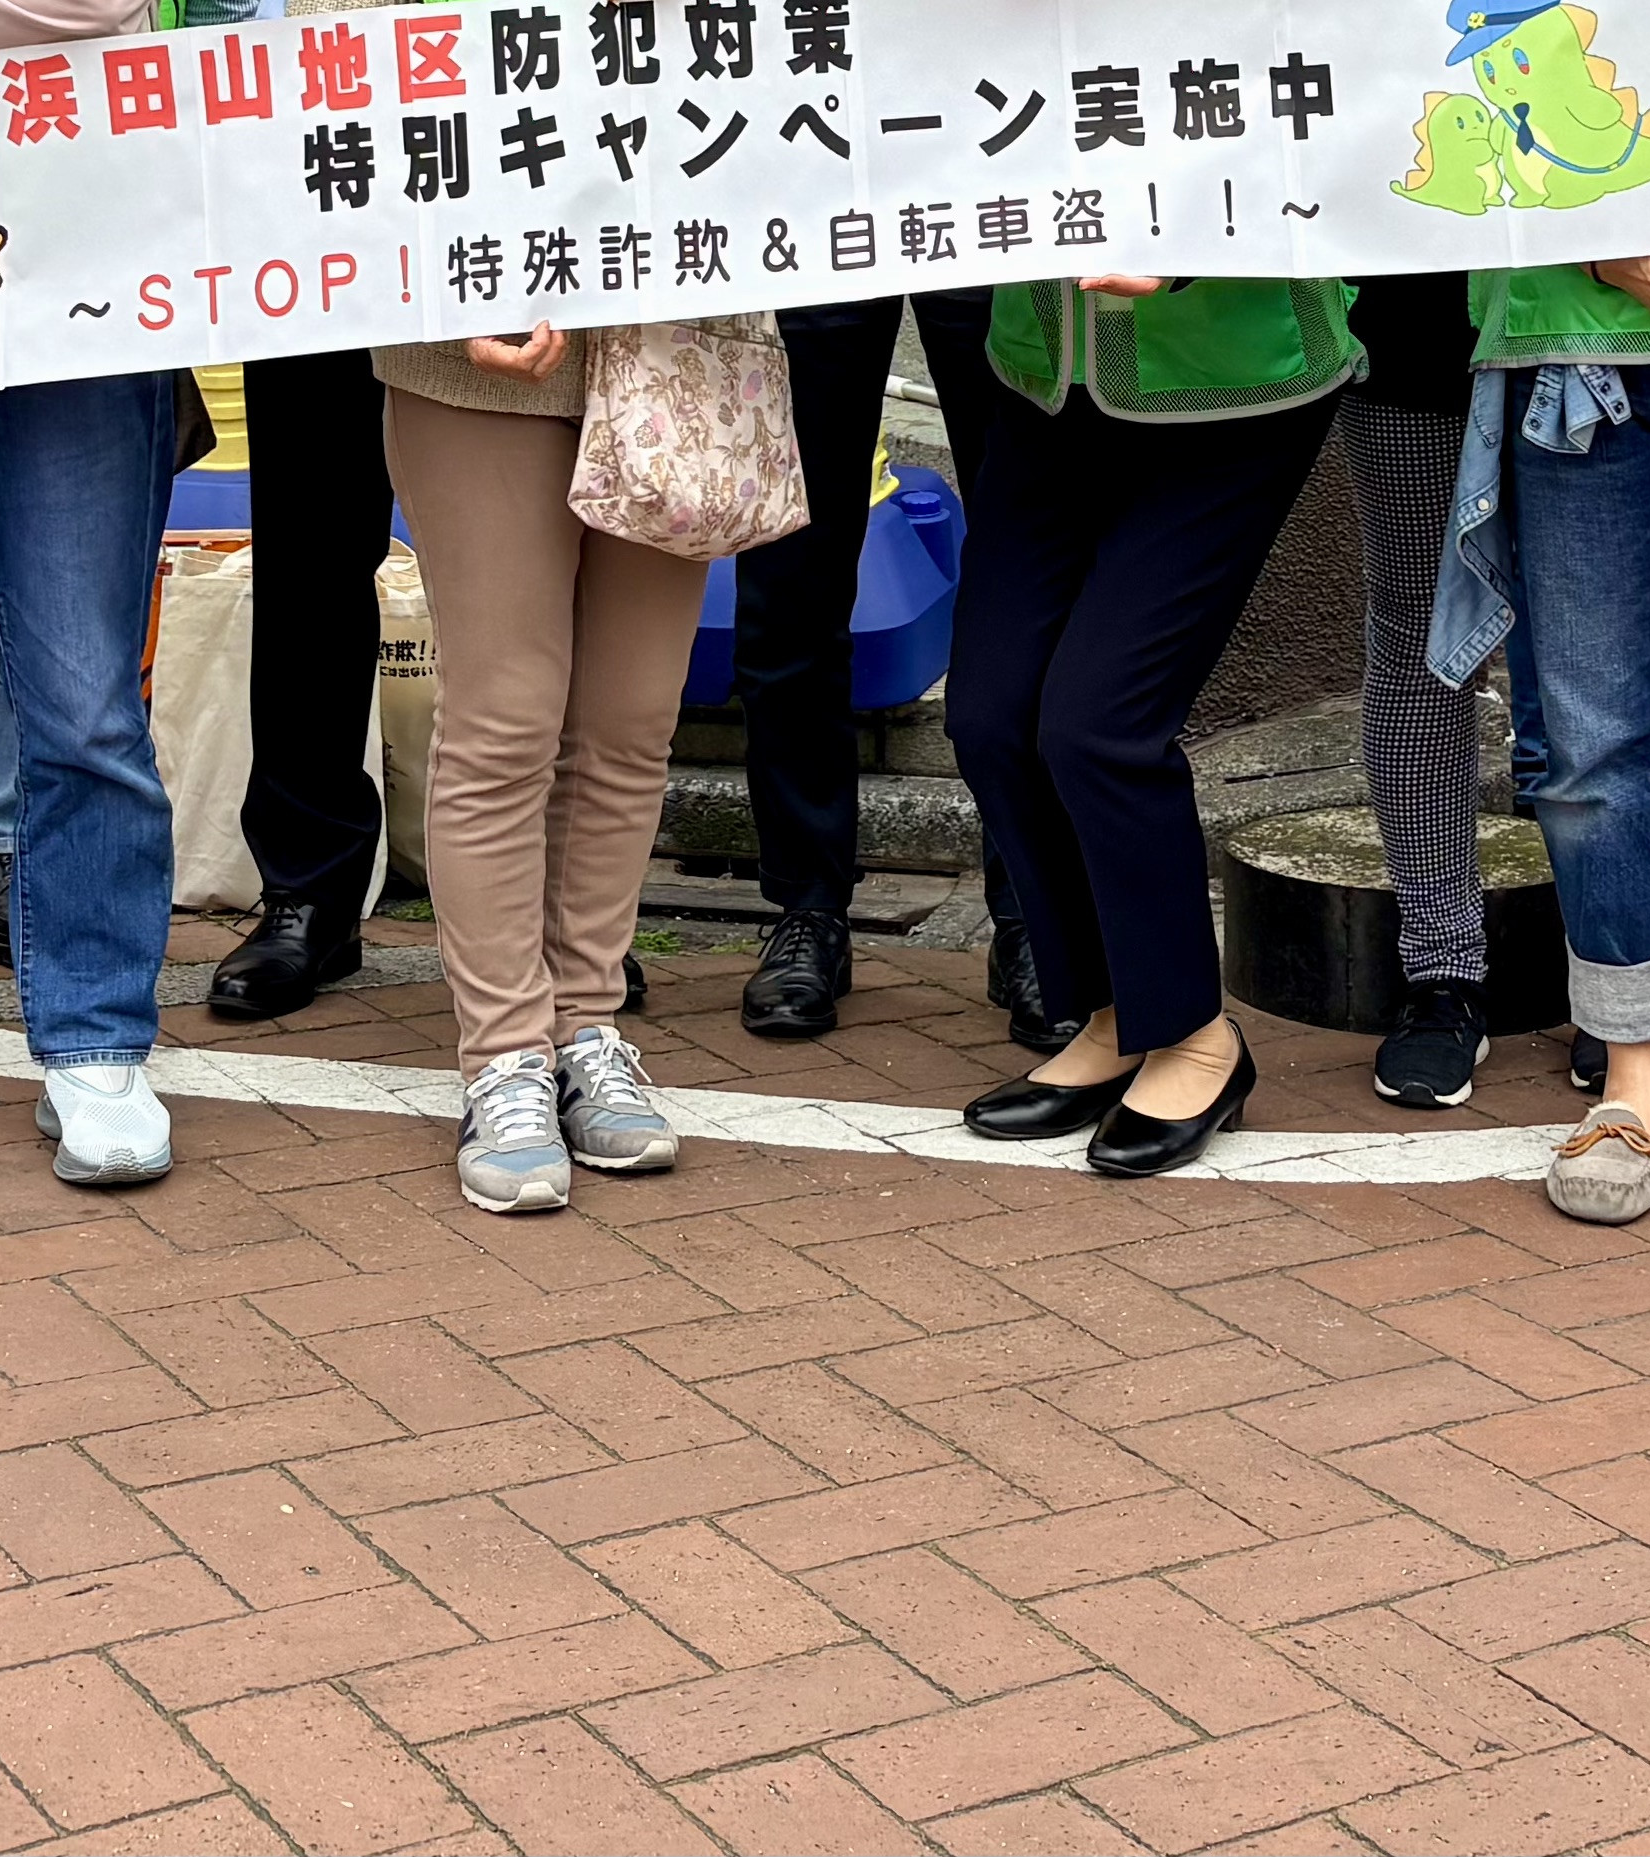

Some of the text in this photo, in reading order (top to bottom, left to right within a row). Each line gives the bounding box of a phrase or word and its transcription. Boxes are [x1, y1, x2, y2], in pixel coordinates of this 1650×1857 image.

[303, 51, 1336, 212] 特別キャンペーン実施中
